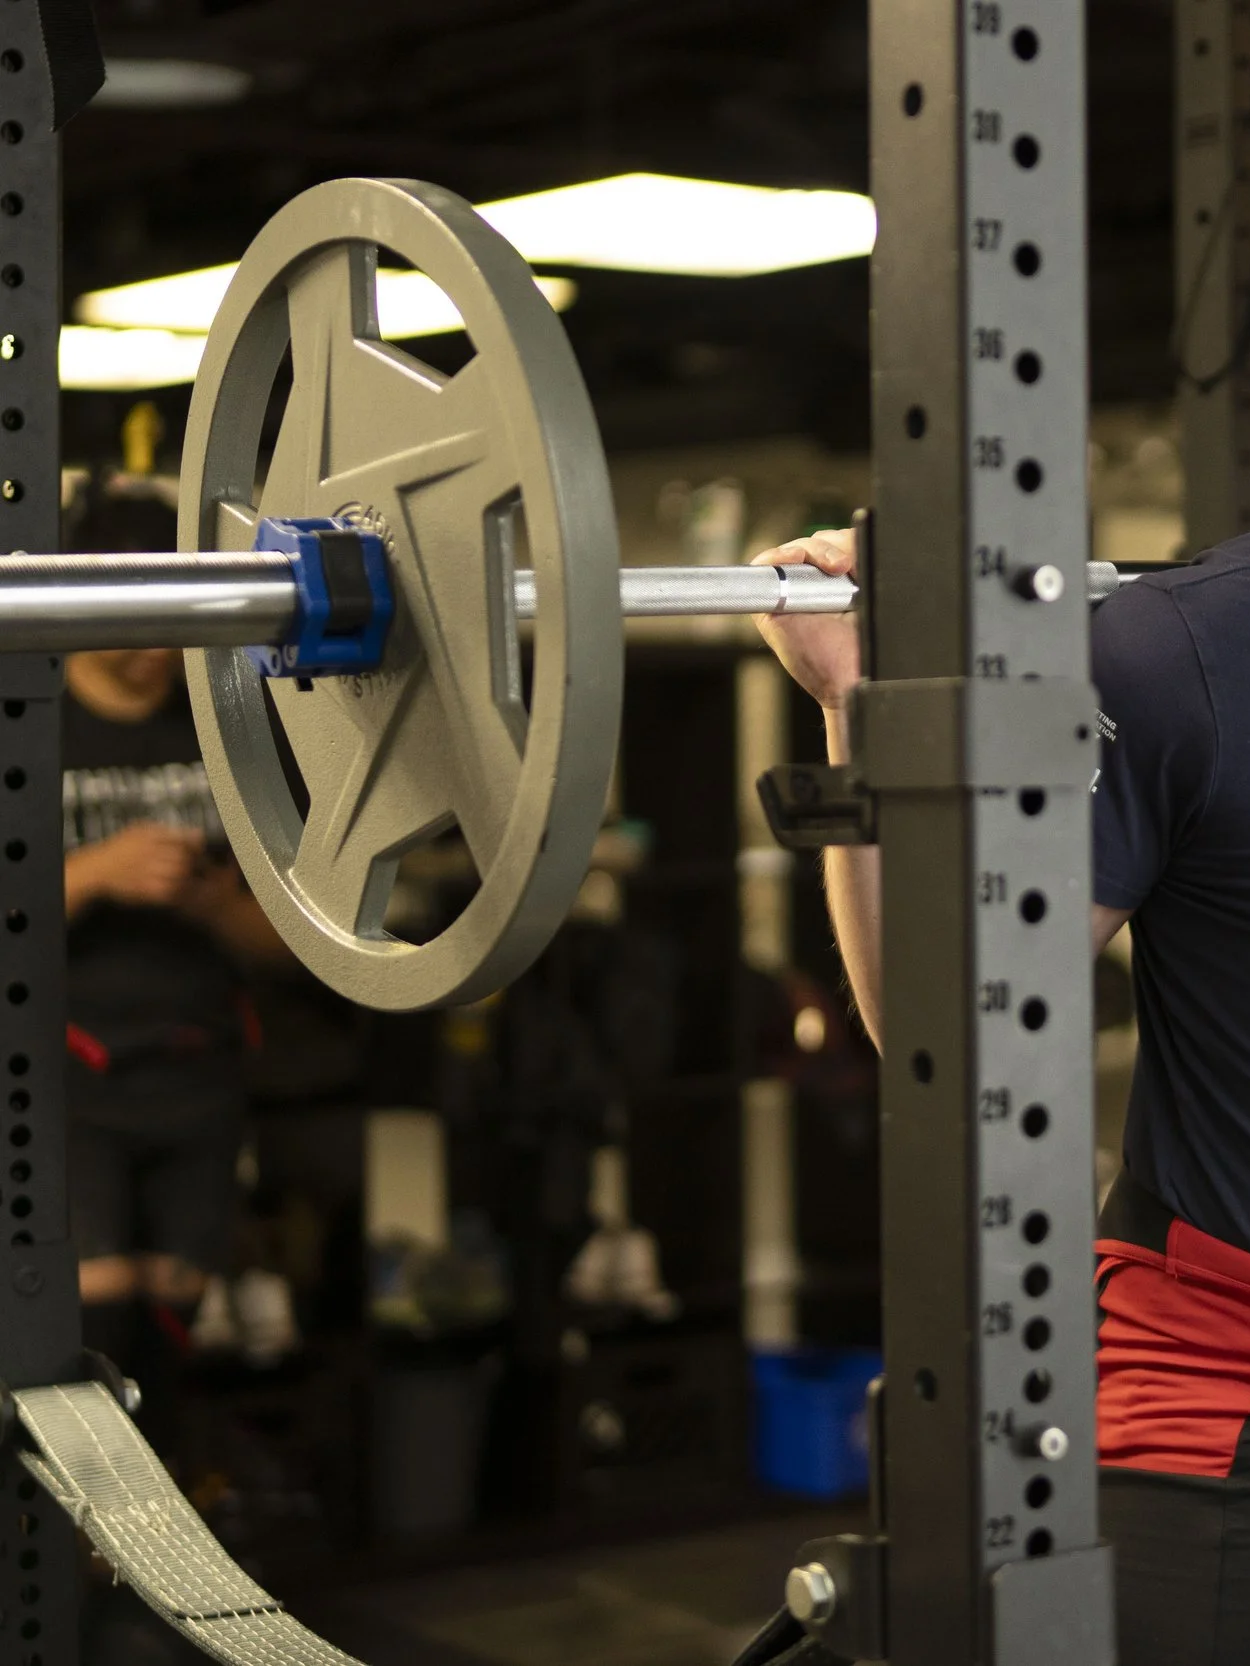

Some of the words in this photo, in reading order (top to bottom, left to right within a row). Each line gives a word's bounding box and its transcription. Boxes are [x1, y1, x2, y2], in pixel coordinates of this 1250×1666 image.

[973, 1, 1002, 36] 39
[973, 109, 1003, 144] 38
[974, 217, 1003, 250] 37
[975, 328, 1004, 361] 36
[976, 436, 1005, 470] 35
[977, 545, 1007, 577] 34
[979, 871, 1007, 903] 31
[980, 979, 1010, 1012] 30
[981, 1087, 1011, 1121] 29
[982, 1195, 1012, 1229] 28
[983, 1303, 1013, 1337] 26
[985, 1408, 1014, 1442] 24
[986, 1515, 1015, 1548] 22
